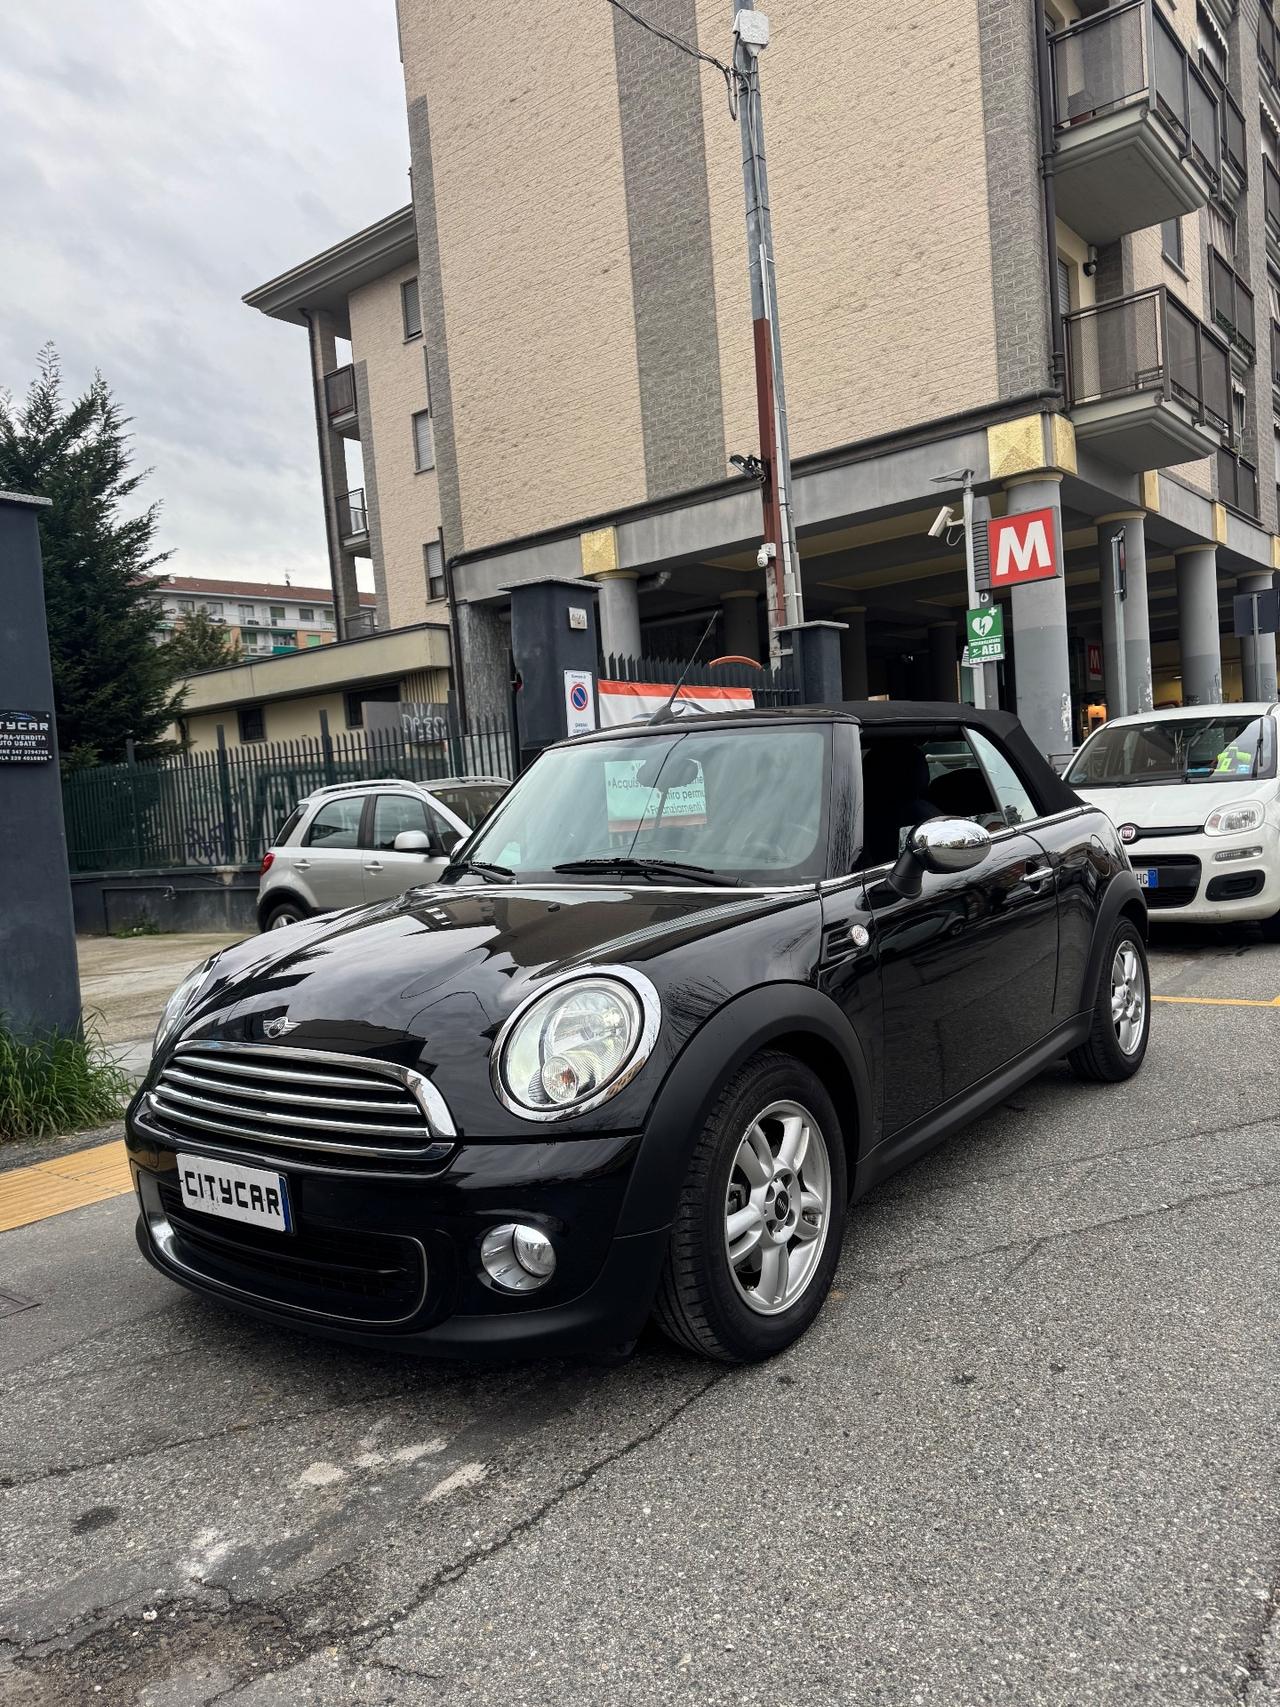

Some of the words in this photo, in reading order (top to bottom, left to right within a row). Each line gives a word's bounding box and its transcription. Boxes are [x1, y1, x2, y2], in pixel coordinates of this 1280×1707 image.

[996, 520, 1051, 576] M
[981, 643, 1001, 656] AED
[1090, 648, 1100, 669] M
[184, 1170, 281, 1216] CITYCAR
